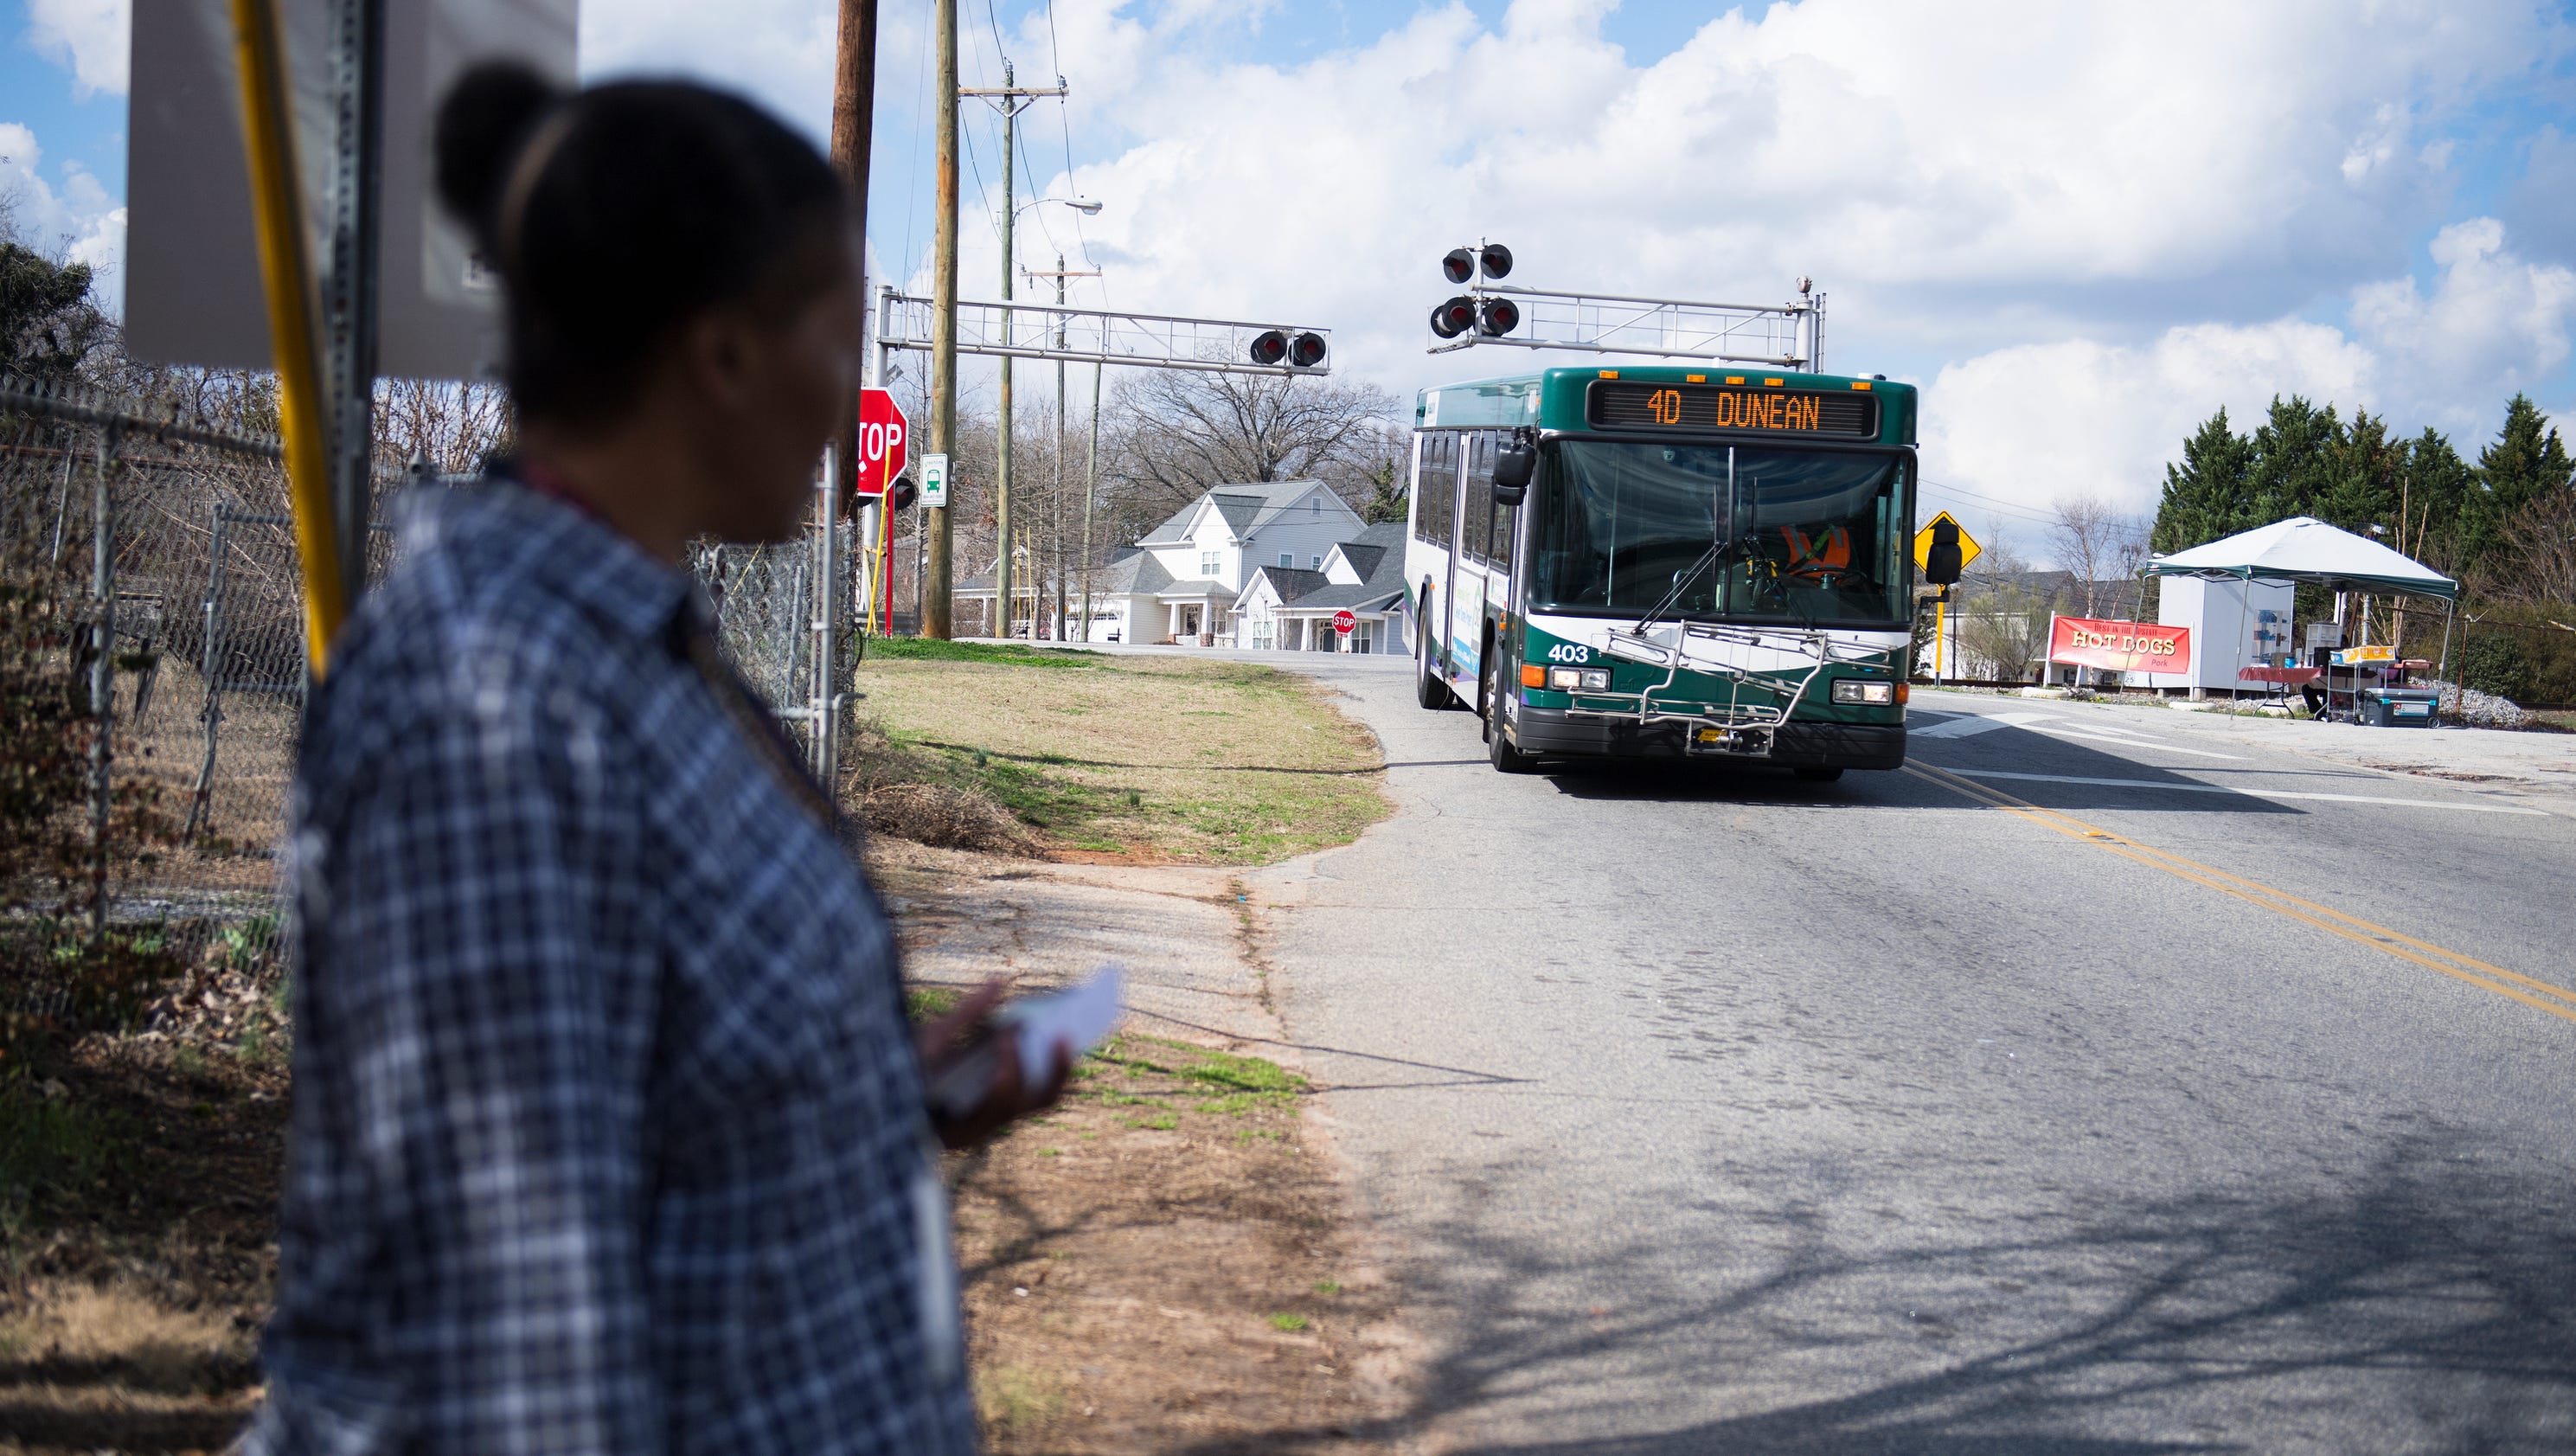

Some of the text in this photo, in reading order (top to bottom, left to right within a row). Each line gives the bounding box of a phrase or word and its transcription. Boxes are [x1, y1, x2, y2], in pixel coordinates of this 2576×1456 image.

[1647, 389, 1820, 430] 4D DUNEAN
[858, 422, 902, 461] TOP
[1334, 616, 1355, 627] STOP
[1548, 644, 1589, 664] 403
[2071, 631, 2116, 651] HOT
[2121, 636, 2176, 657] DOGS
[2151, 658, 2168, 667] Pork
